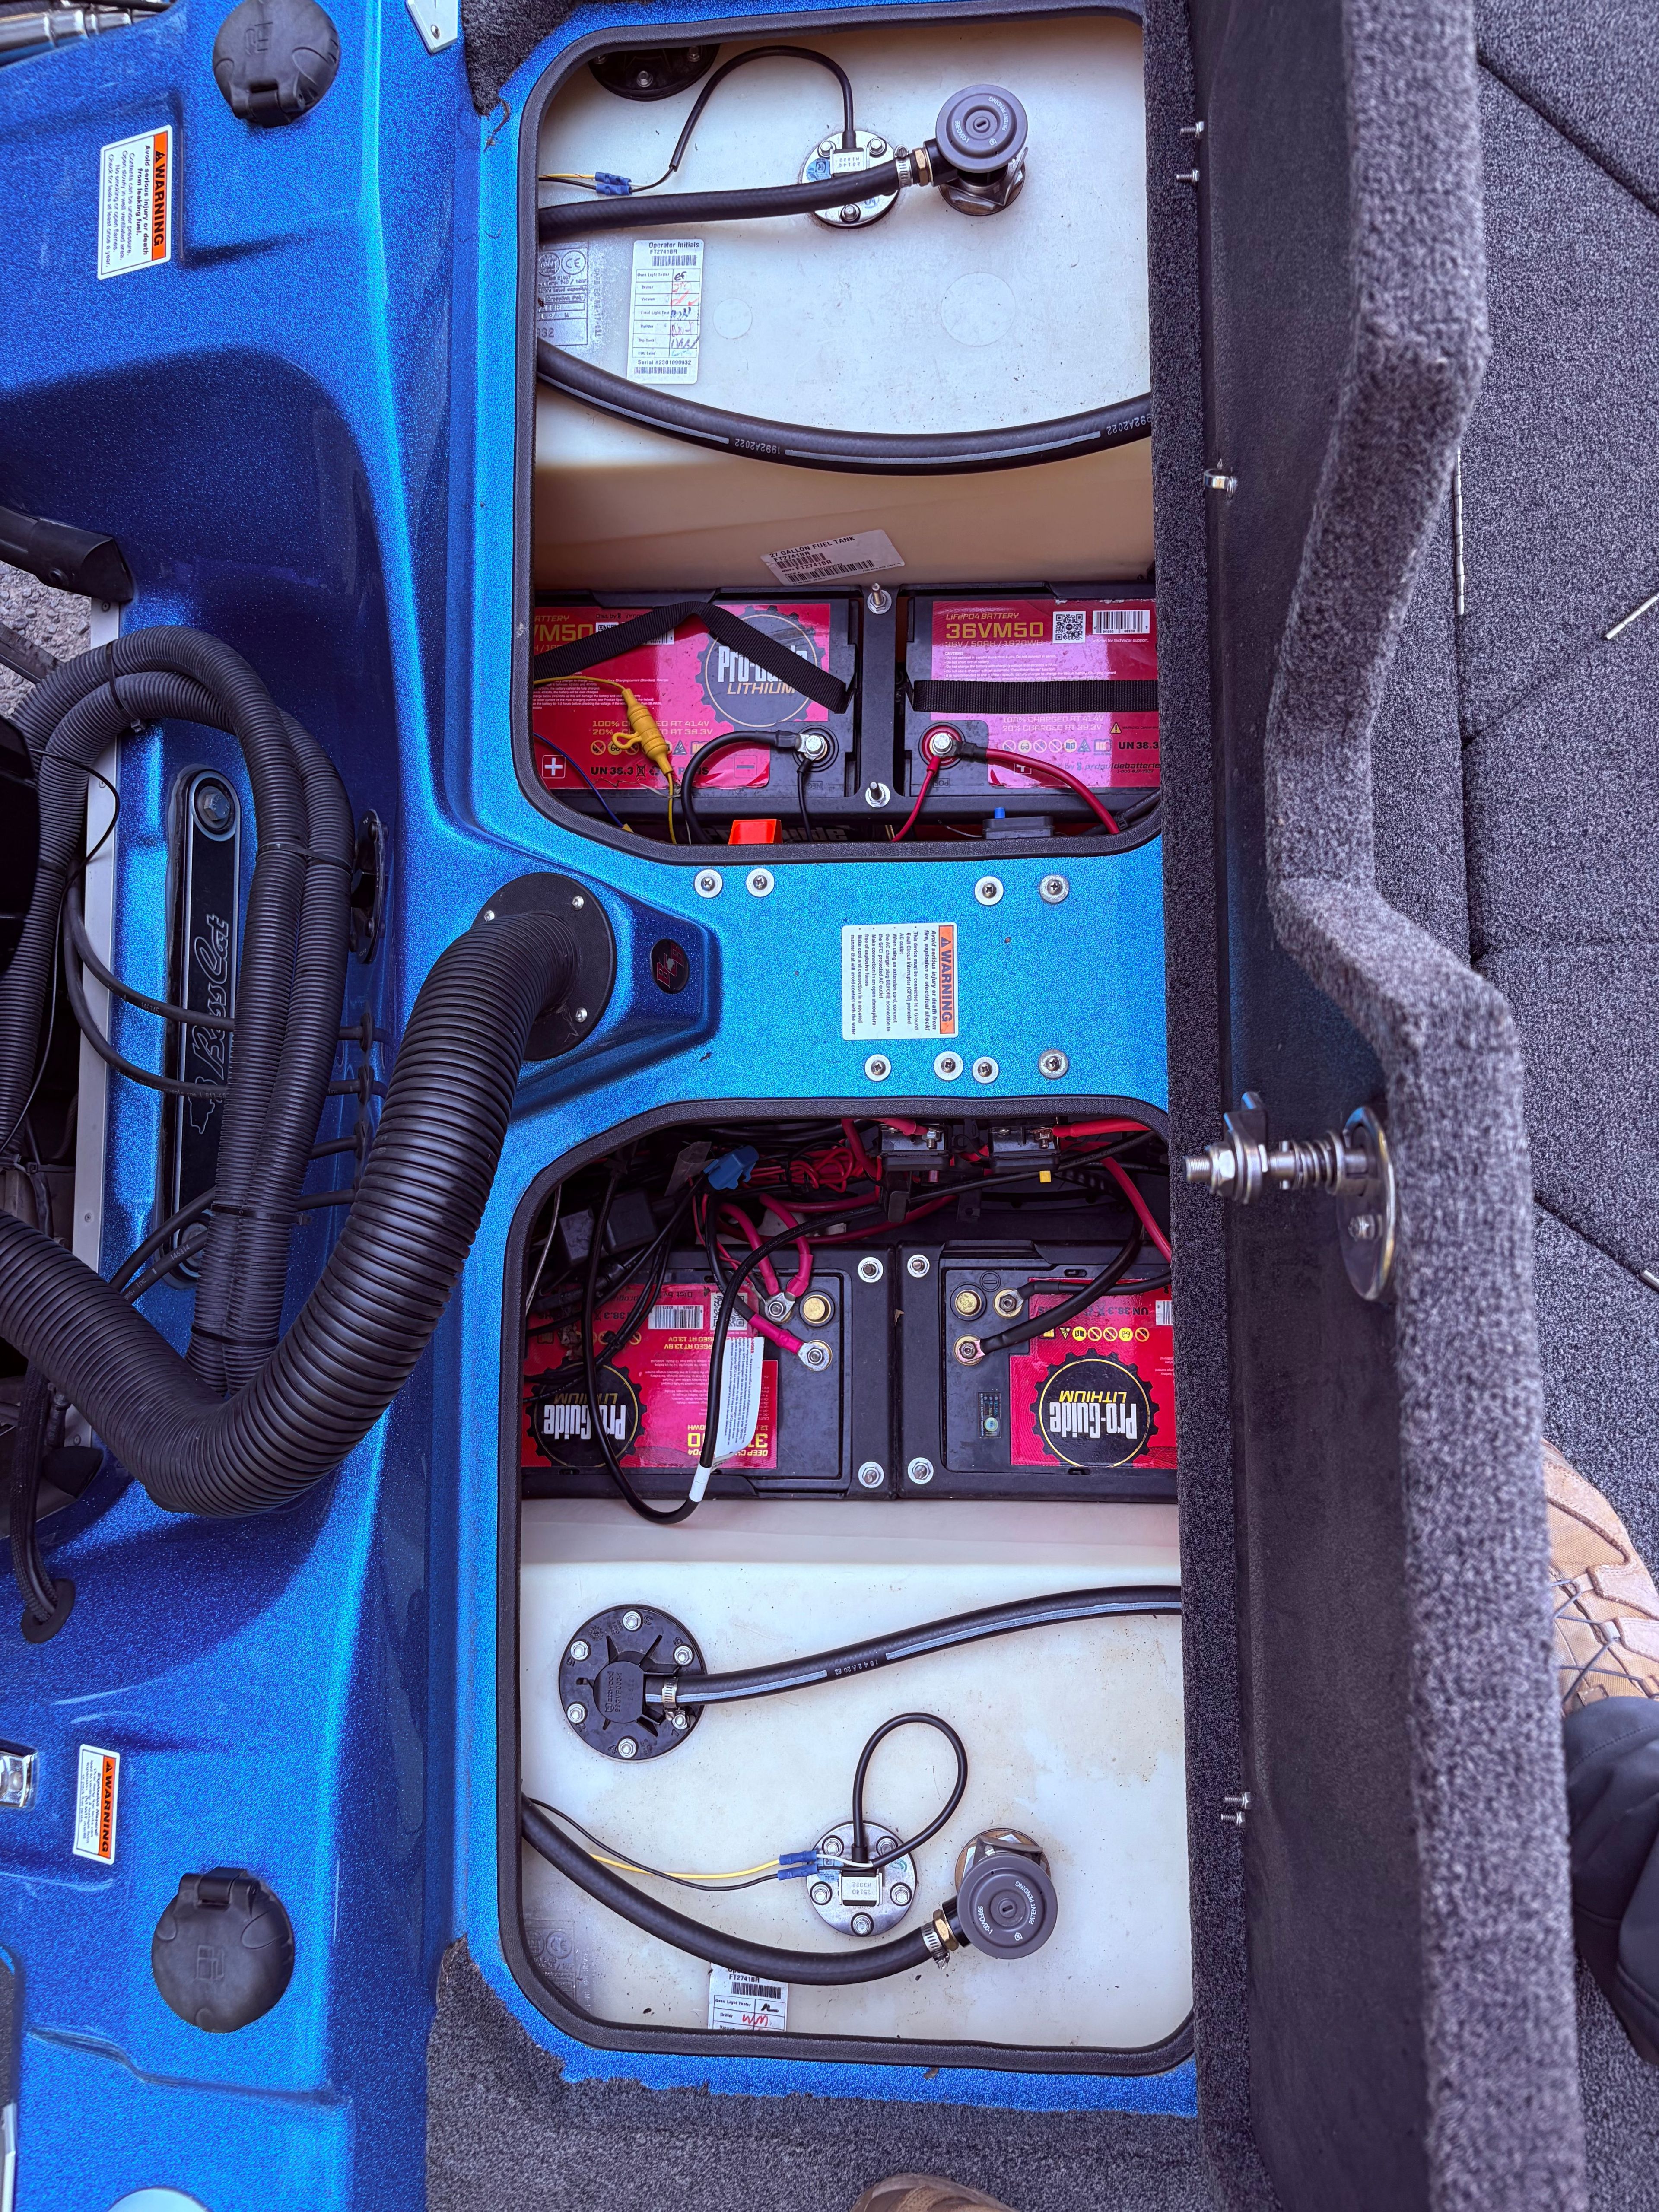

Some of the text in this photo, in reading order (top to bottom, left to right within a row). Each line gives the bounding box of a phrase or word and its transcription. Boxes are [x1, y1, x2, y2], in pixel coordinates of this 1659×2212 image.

[154, 164, 165, 246] WARNING
[735, 438, 780, 454] 1992A2022
[781, 546, 810, 556] GALLON
[833, 536, 855, 544] TANK
[946, 622, 1044, 639] 36VM50
[727, 682, 796, 695] LITHIUM
[591, 767, 607, 775] UN
[941, 950, 953, 1022] WARNING
[1107, 1307, 1148, 1315] UN 38.3
[1059, 1390, 1127, 1403] LITHIUM
[1049, 1402, 1137, 1439] Pro-Guide
[102, 1775, 112, 1853] WARNING
[1015, 1881, 1034, 1902] PENDING
